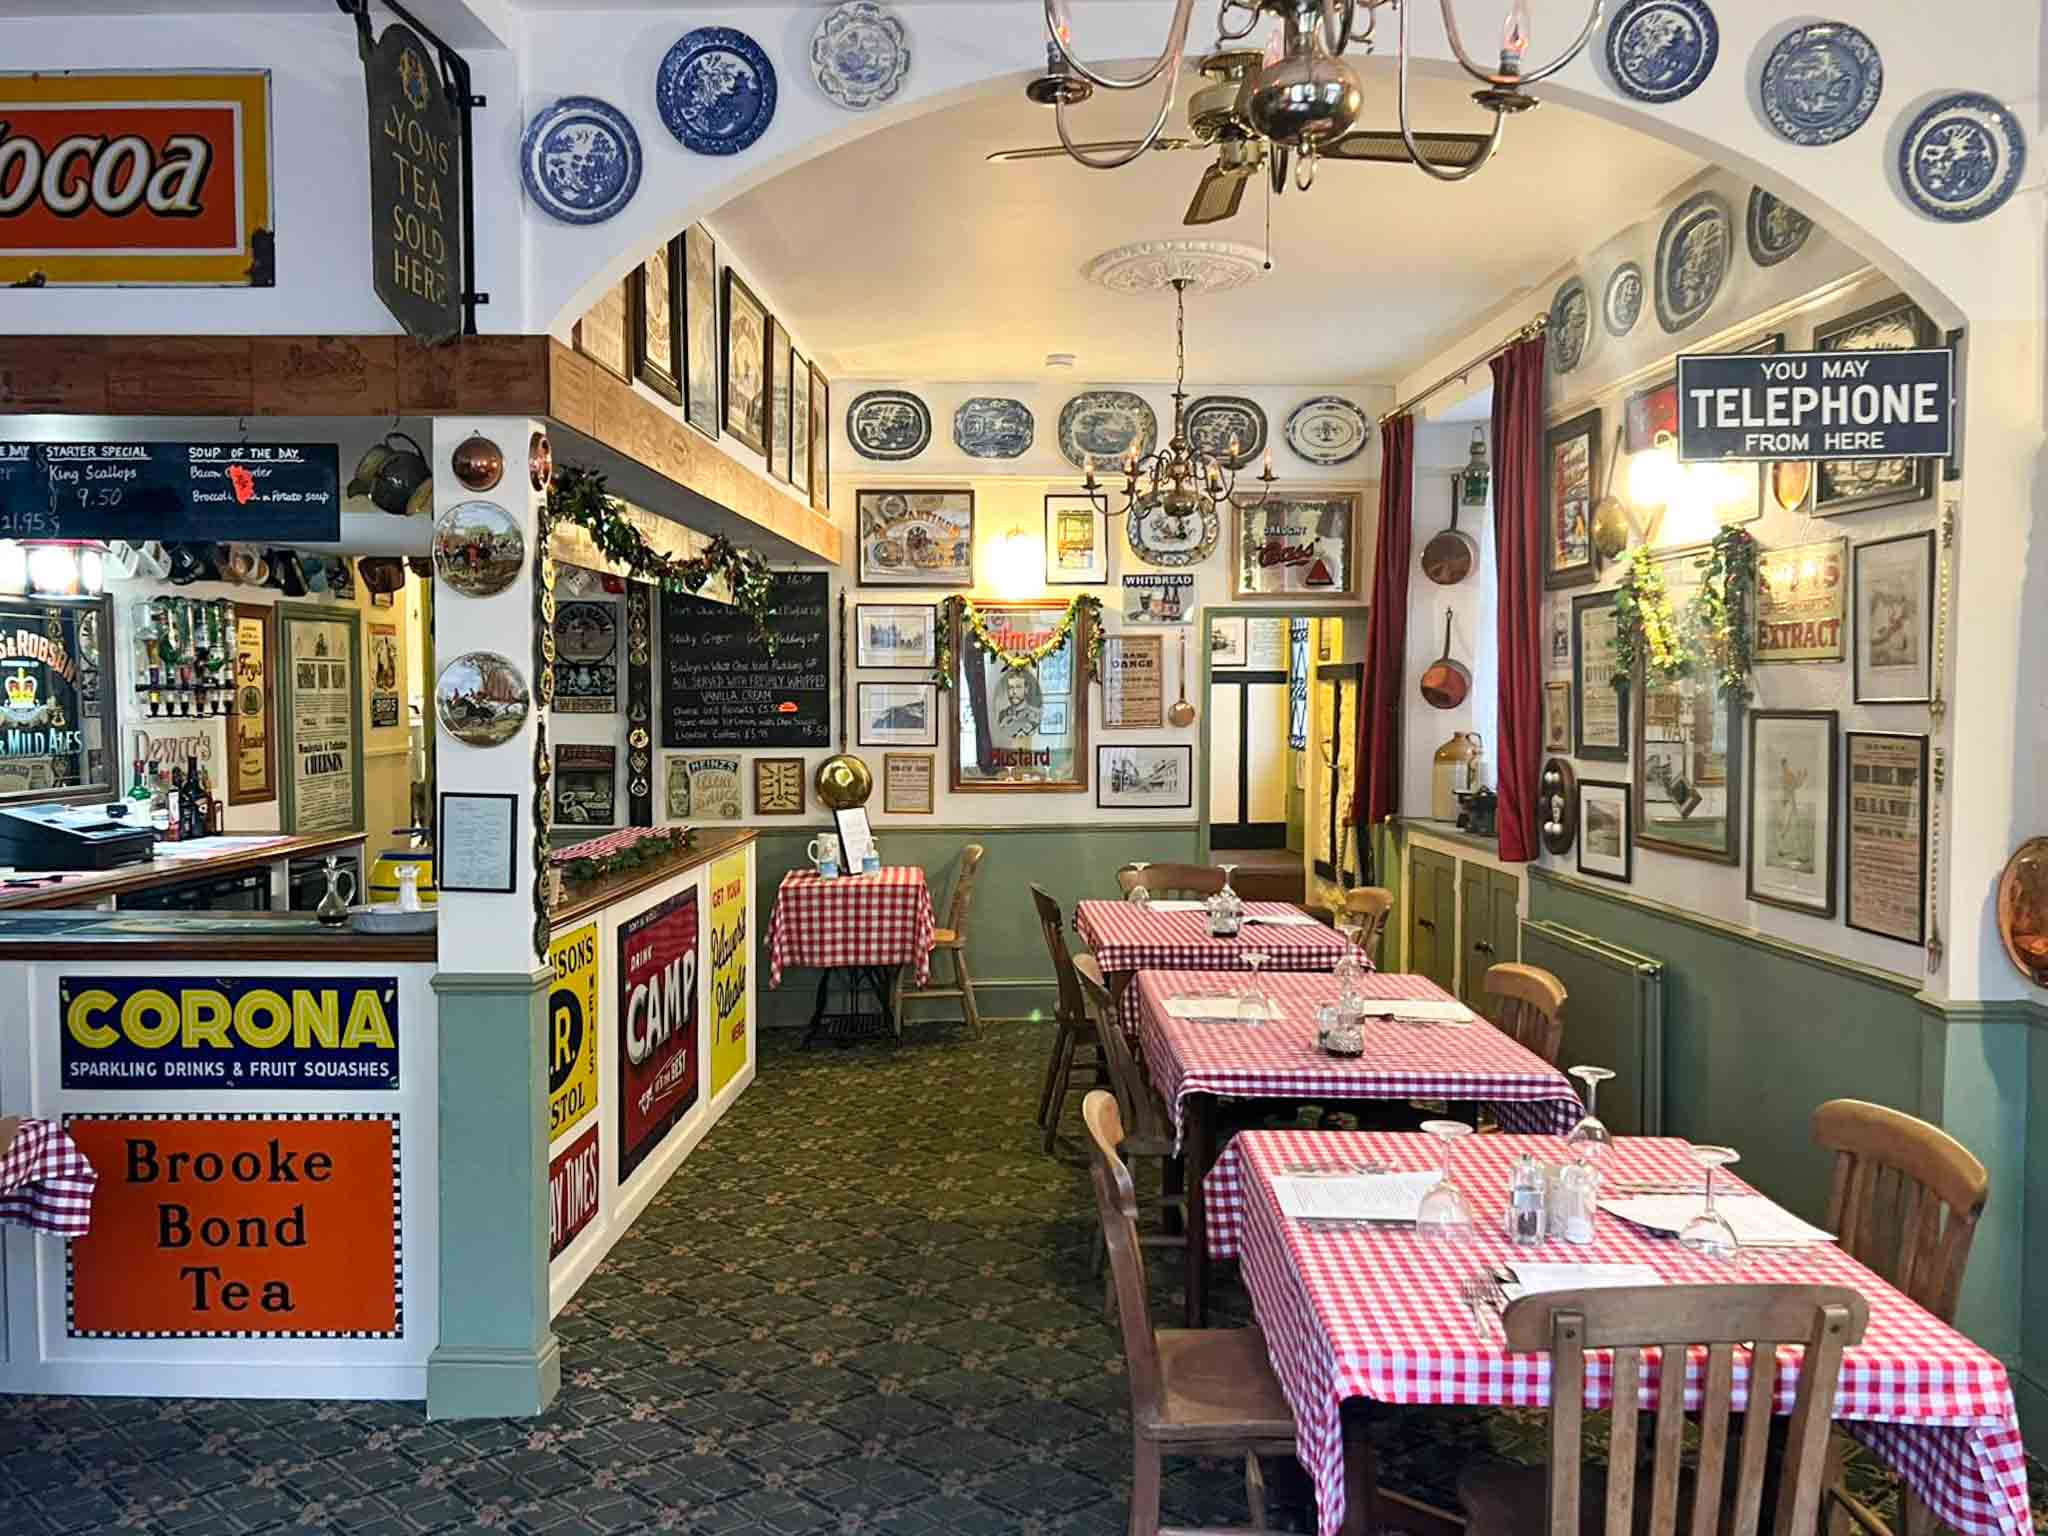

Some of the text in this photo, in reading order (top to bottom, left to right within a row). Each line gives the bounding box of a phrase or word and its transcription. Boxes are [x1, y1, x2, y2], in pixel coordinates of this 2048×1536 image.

[0, 121, 209, 214] ocoa
[392, 152, 443, 223] TEA
[393, 205, 445, 265] SOLD
[1761, 360, 1869, 380] YOU MAY
[1690, 383, 1939, 429] TELEPHONE
[9, 445, 31, 458] DAY
[46, 446, 148, 458] STARTER SPECIAL
[188, 448, 221, 459] SOUP
[231, 448, 244, 458] OF
[251, 448, 272, 459] THE
[1745, 431, 1885, 452] FROM HERE
[49, 464, 137, 484] King Scallops
[190, 465, 222, 478] Bacon
[77, 487, 123, 508] 9.50
[192, 489, 233, 501] Broccoli
[305, 491, 329, 504] soup
[1125, 575, 1192, 587] WHITBREAD
[1758, 619, 1840, 650] EXTRACT
[8, 728, 82, 755] MILD ALES
[712, 887, 724, 909] GET
[630, 944, 653, 973] DRINK
[70, 1061, 391, 1078] SPARKLING DRINKS & FRUIT SQUASHES
[551, 1082, 585, 1130] STOL
[125, 1137, 334, 1184] Brooke
[565, 1142, 597, 1231] TIMES
[157, 1203, 308, 1248] Bond
[180, 1266, 296, 1313] Tea
